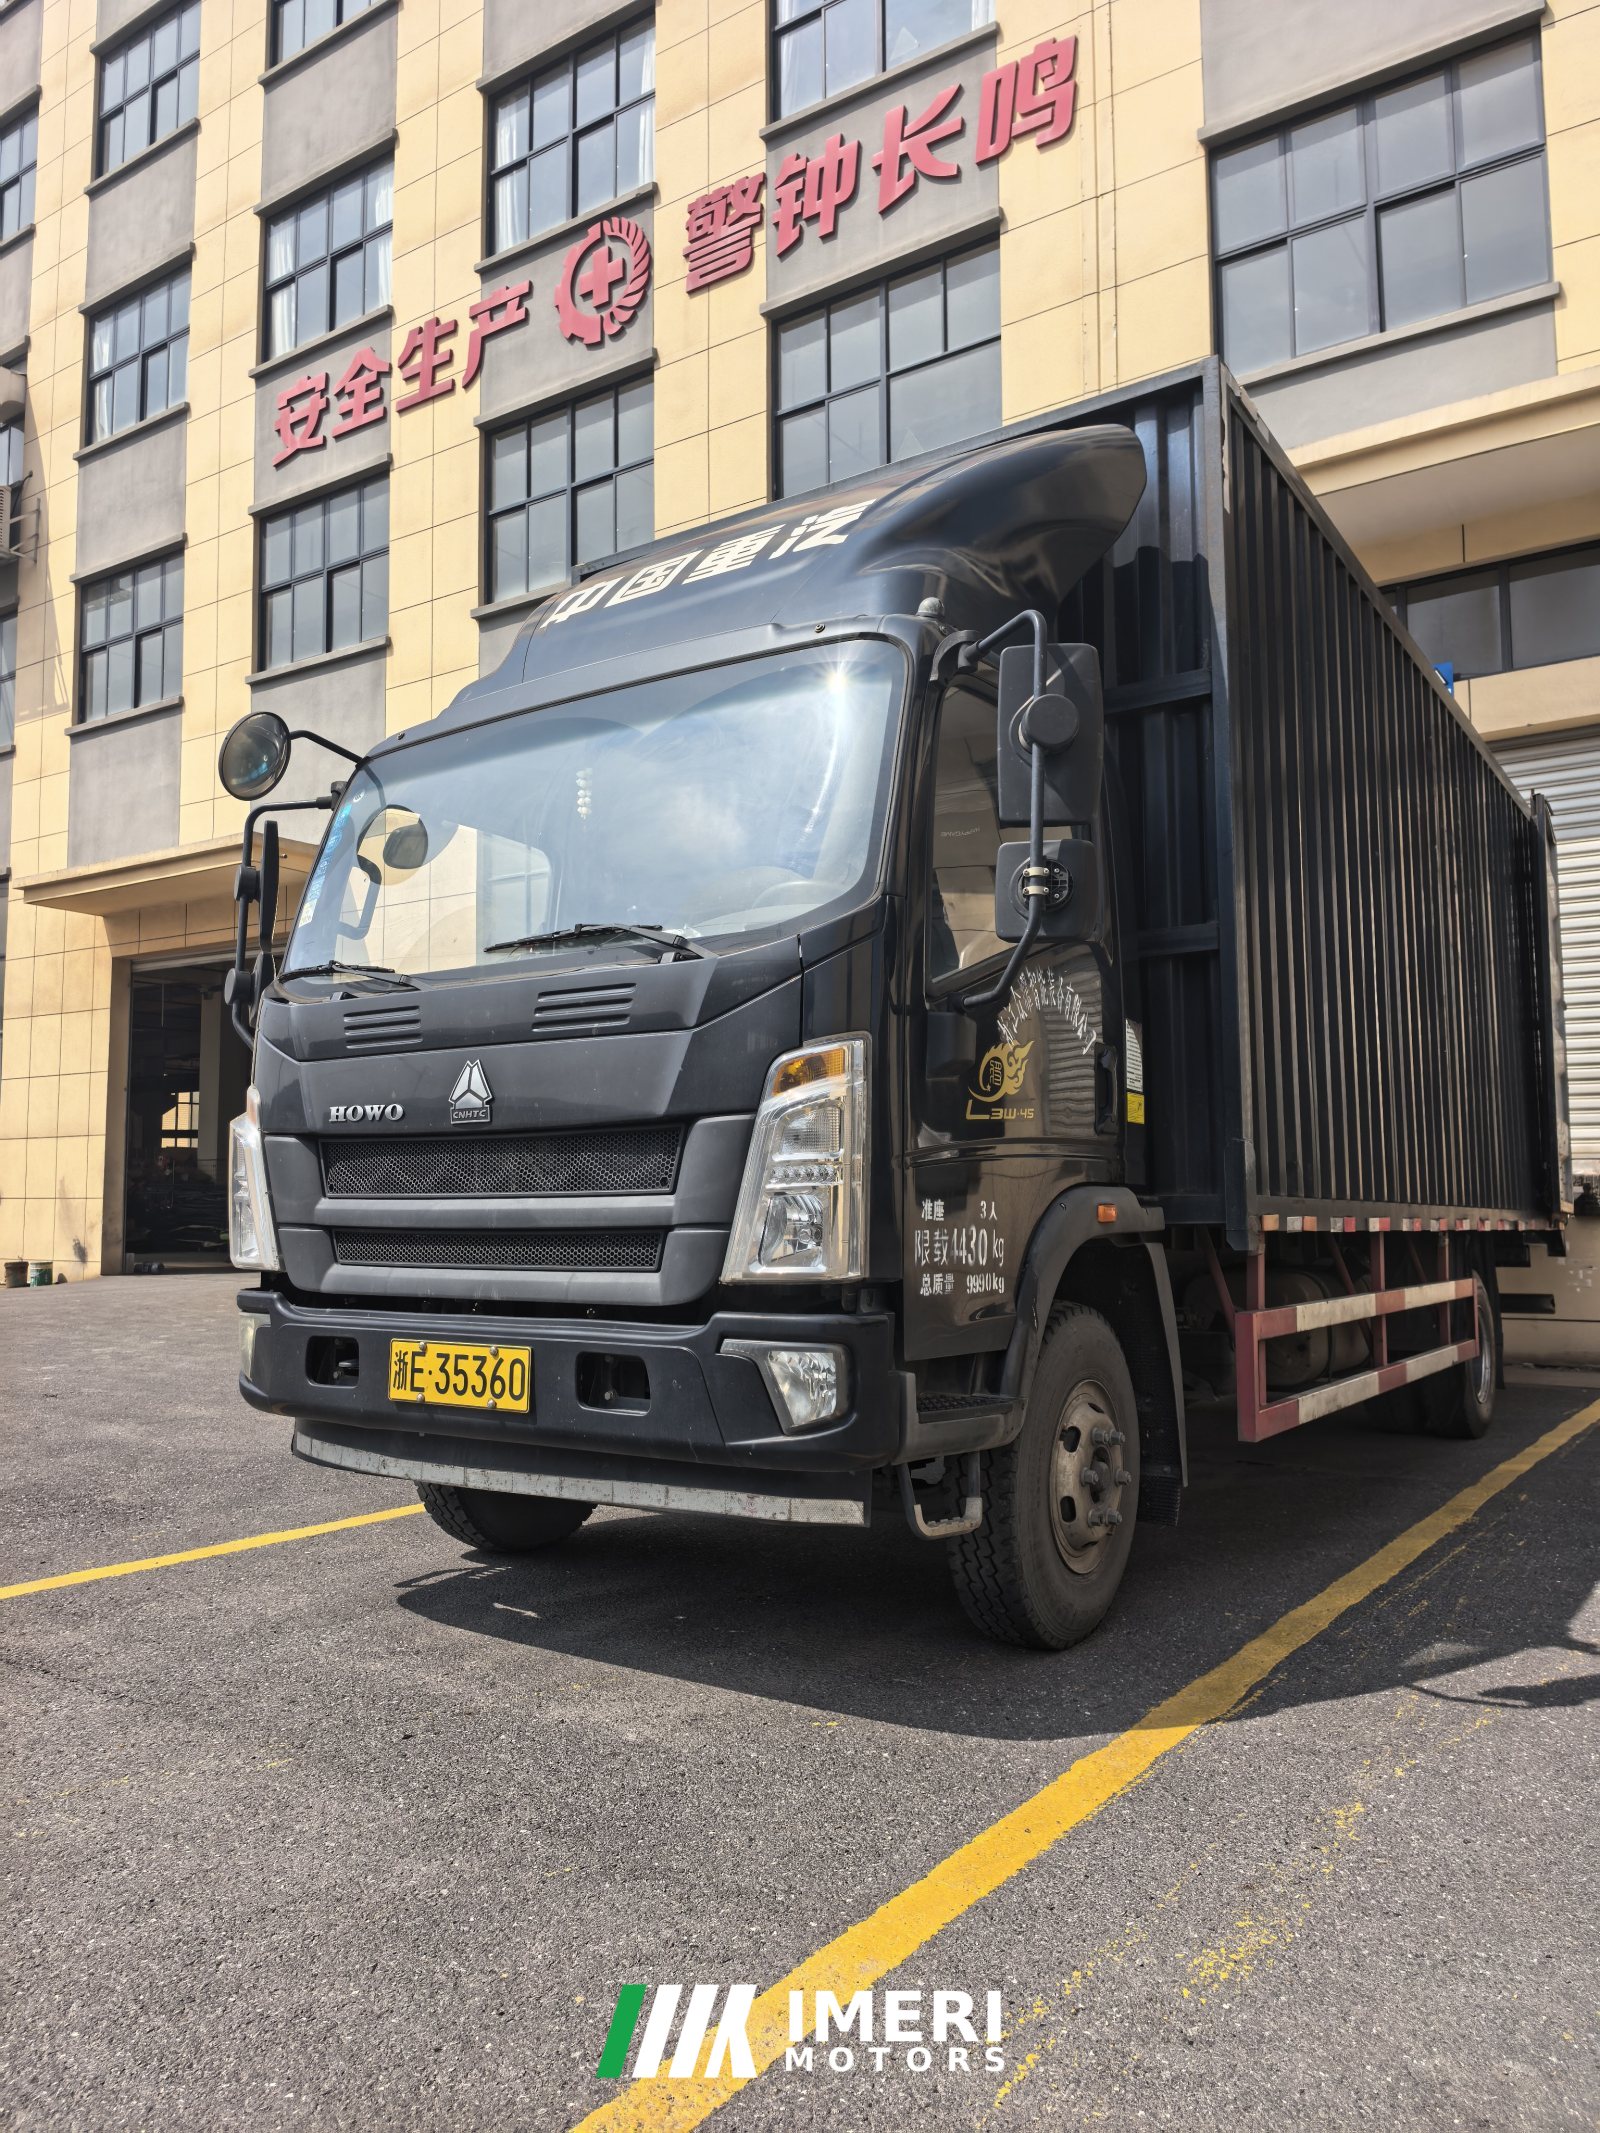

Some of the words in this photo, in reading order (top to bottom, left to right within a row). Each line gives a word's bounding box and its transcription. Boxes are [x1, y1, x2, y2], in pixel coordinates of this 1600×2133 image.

[272, 280, 532, 467] 安全生产
[683, 34, 1077, 293] 警钟长鸣
[540, 499, 877, 629] 中国重汽
[329, 1103, 404, 1123] HOWO
[452, 1109, 487, 1119] CNHTC
[921, 1198, 945, 1222] 准座
[920, 1273, 955, 1296] 总质量
[392, 1349, 526, 1402] 浙E·35360
